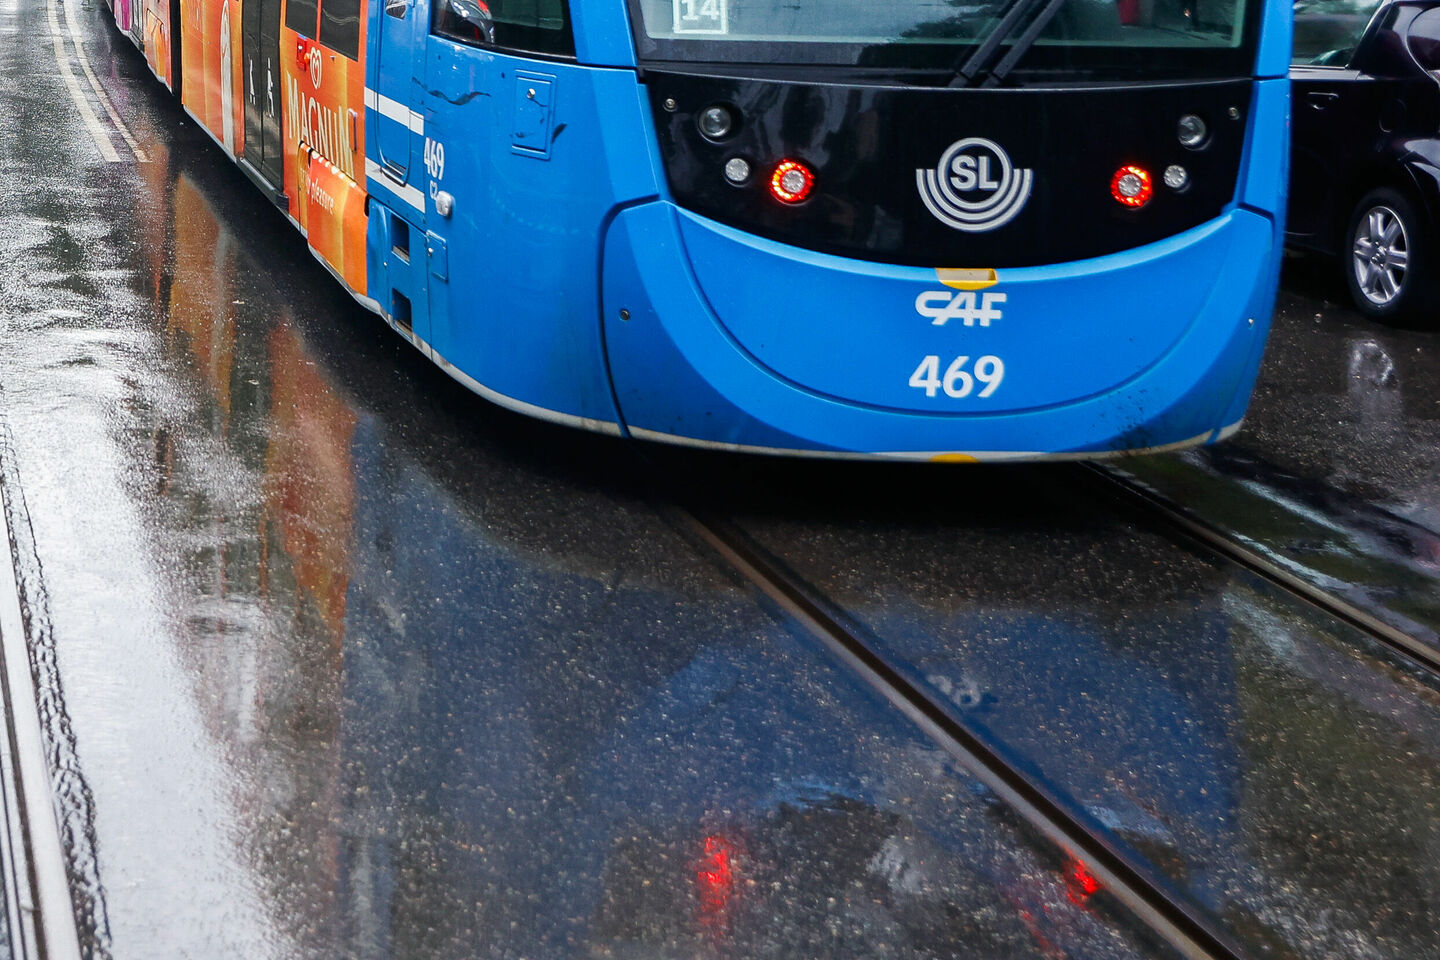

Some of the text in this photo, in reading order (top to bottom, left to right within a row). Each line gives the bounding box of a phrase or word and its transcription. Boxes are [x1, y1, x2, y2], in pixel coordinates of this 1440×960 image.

[286, 69, 355, 179] MAGNUM
[424, 136, 445, 181] 469
[950, 155, 998, 191] SL
[311, 177, 335, 215] pleasure
[915, 290, 1007, 327] CAF
[908, 355, 1004, 399] 469
